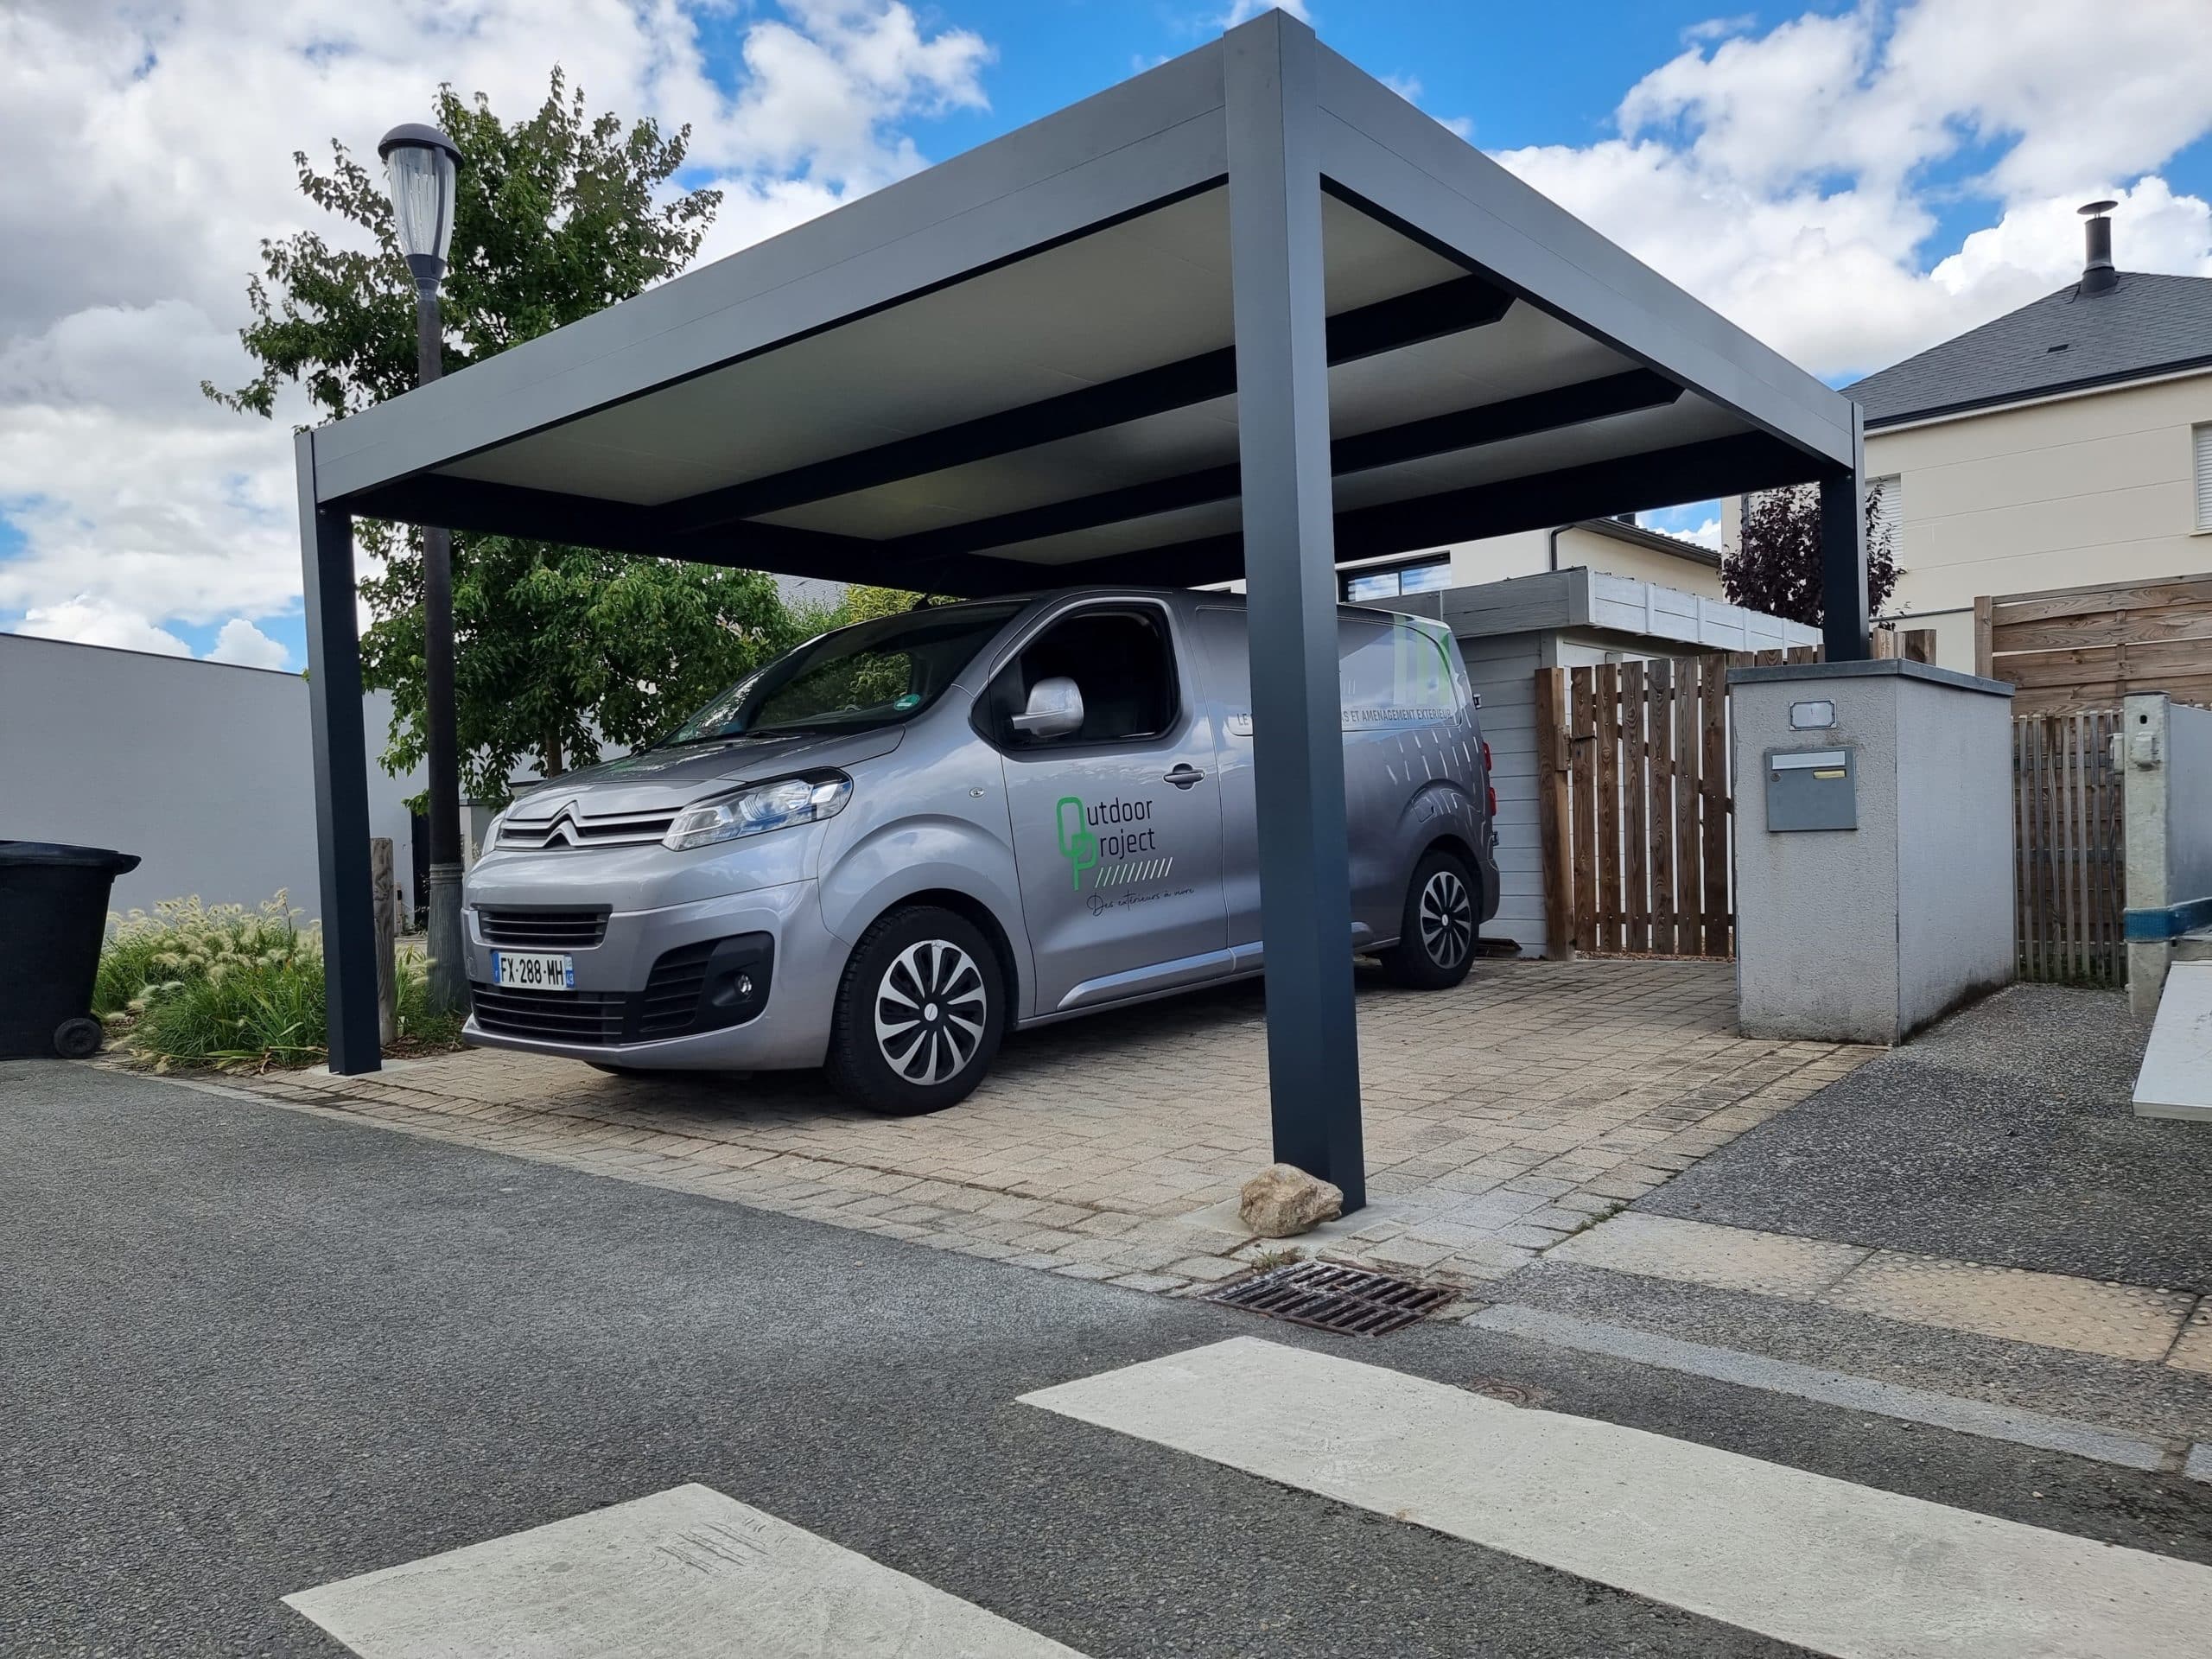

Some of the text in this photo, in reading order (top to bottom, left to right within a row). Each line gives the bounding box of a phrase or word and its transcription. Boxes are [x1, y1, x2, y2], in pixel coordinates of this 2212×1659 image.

[1236, 713, 1249, 726] LE
[1351, 710, 1360, 722] ET
[1362, 709, 1415, 722] AMENAGEMENT
